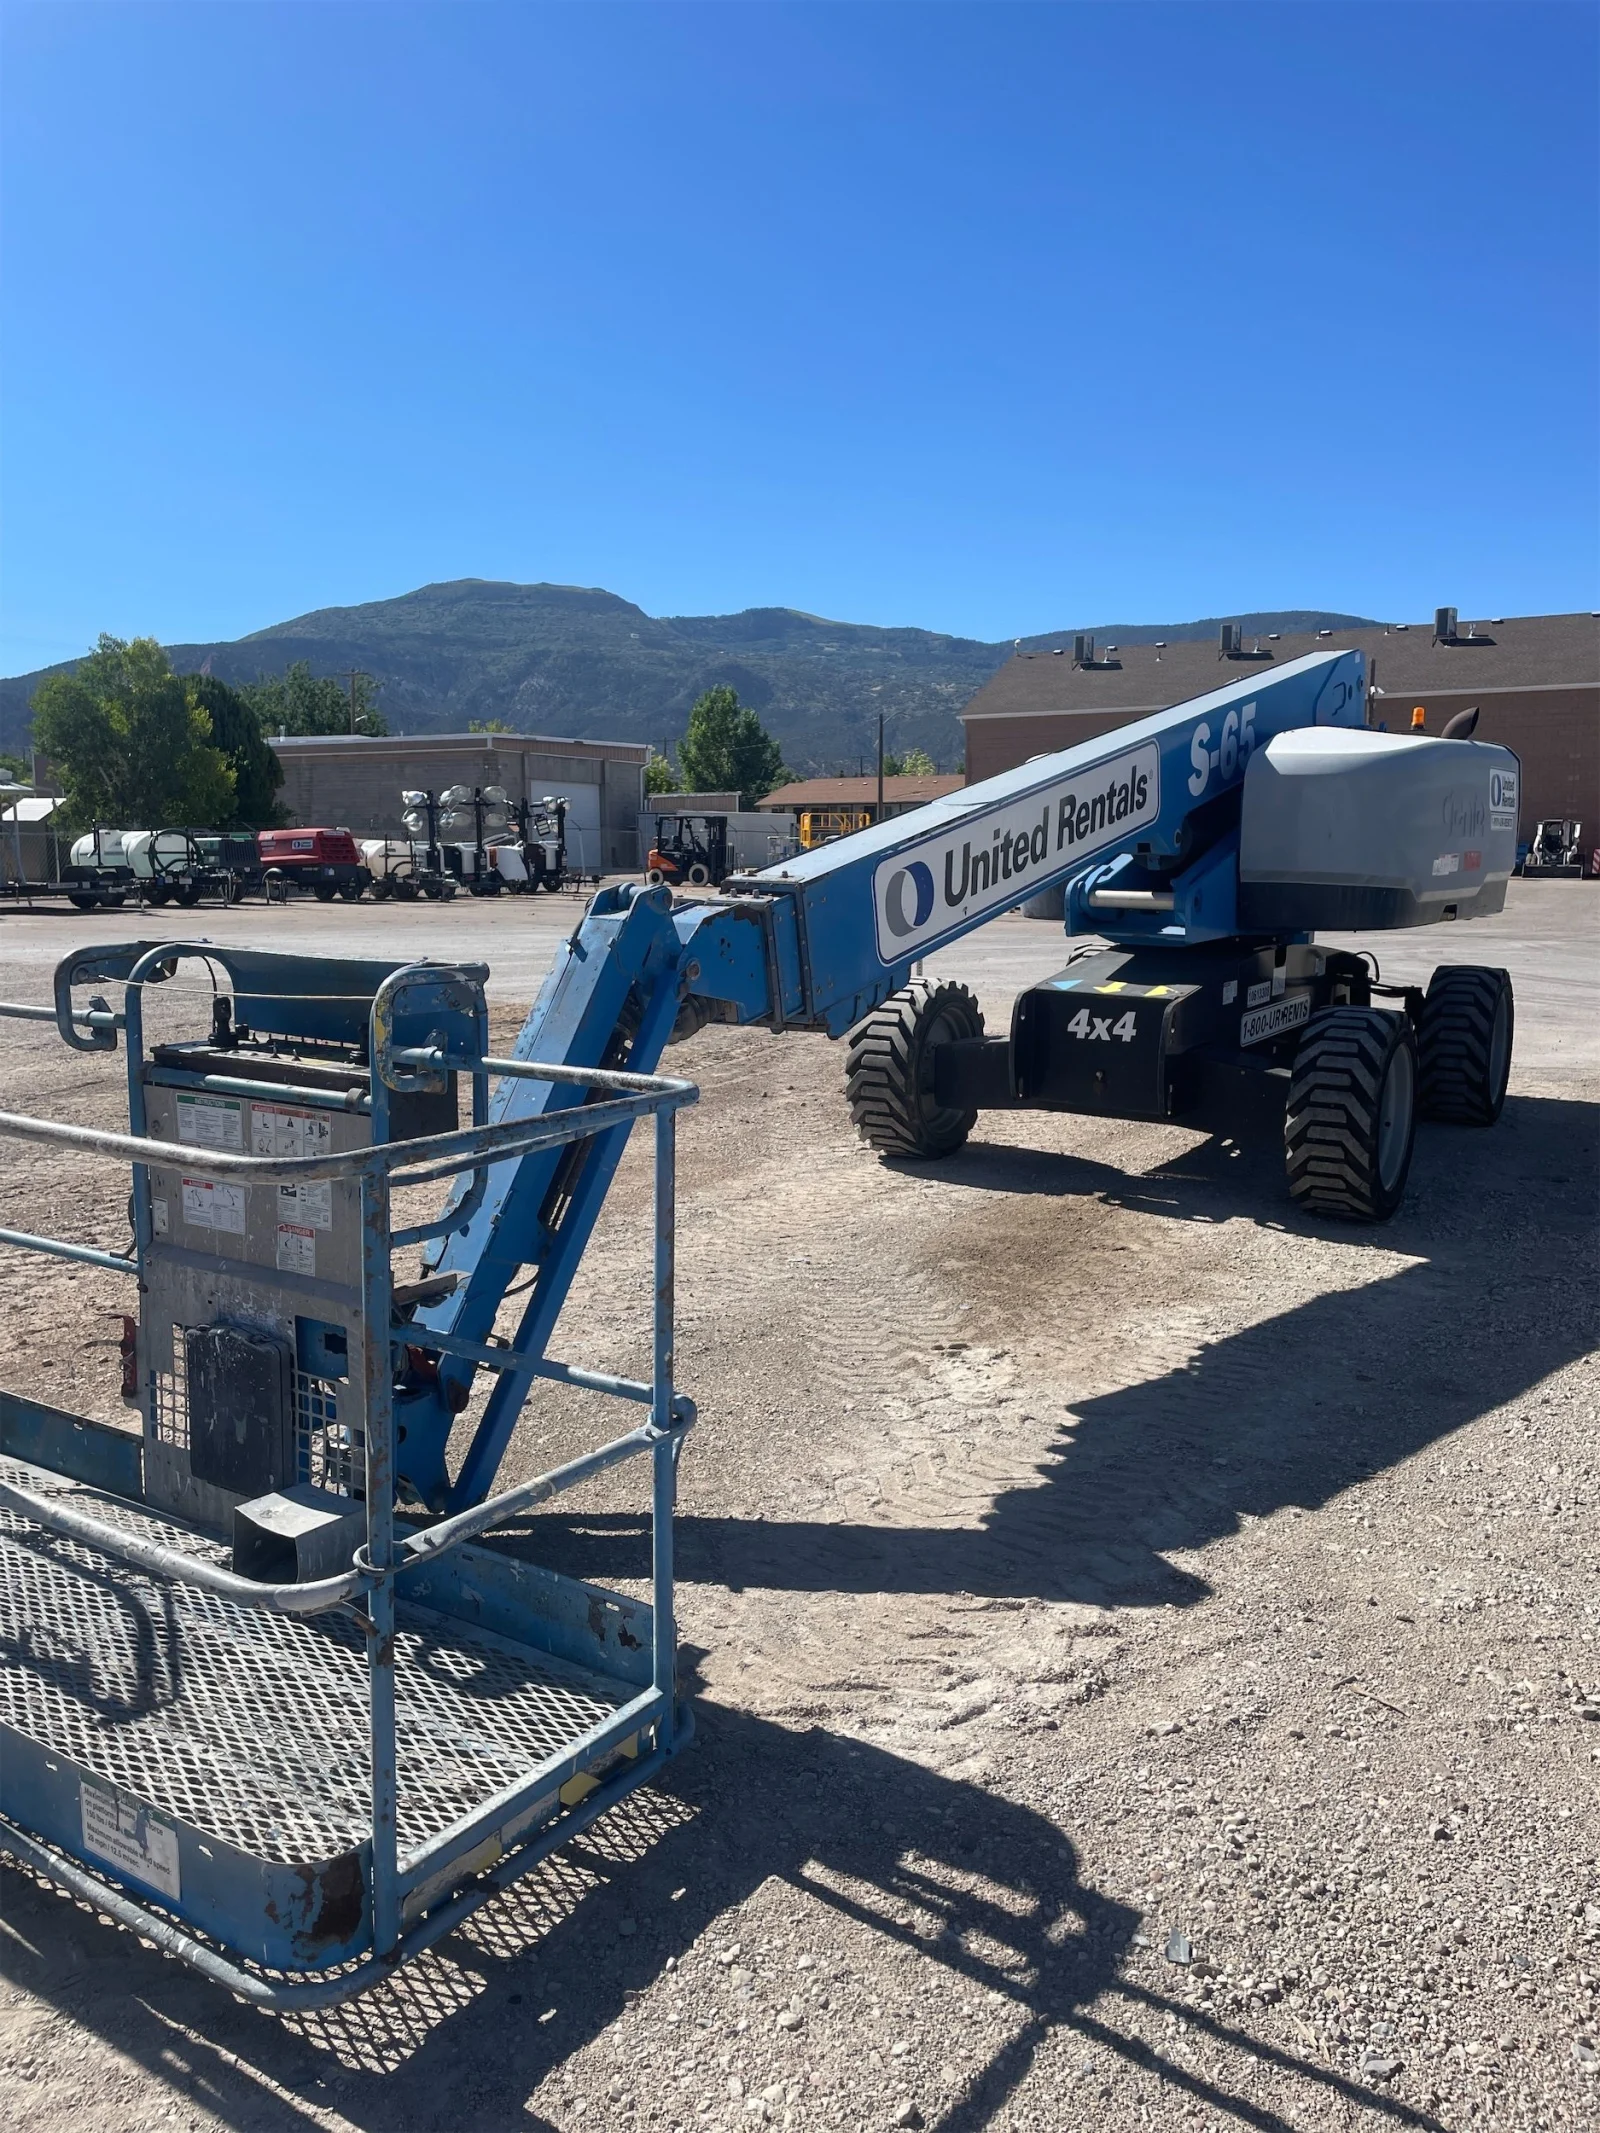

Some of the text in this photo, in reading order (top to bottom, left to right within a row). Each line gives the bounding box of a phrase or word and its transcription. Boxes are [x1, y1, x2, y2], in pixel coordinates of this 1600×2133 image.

[1187, 701, 1258, 797] S-65
[943, 765, 1147, 907] United Rentals
[1067, 1008, 1137, 1042] 4x4
[286, 1225, 311, 1237] DANGER
